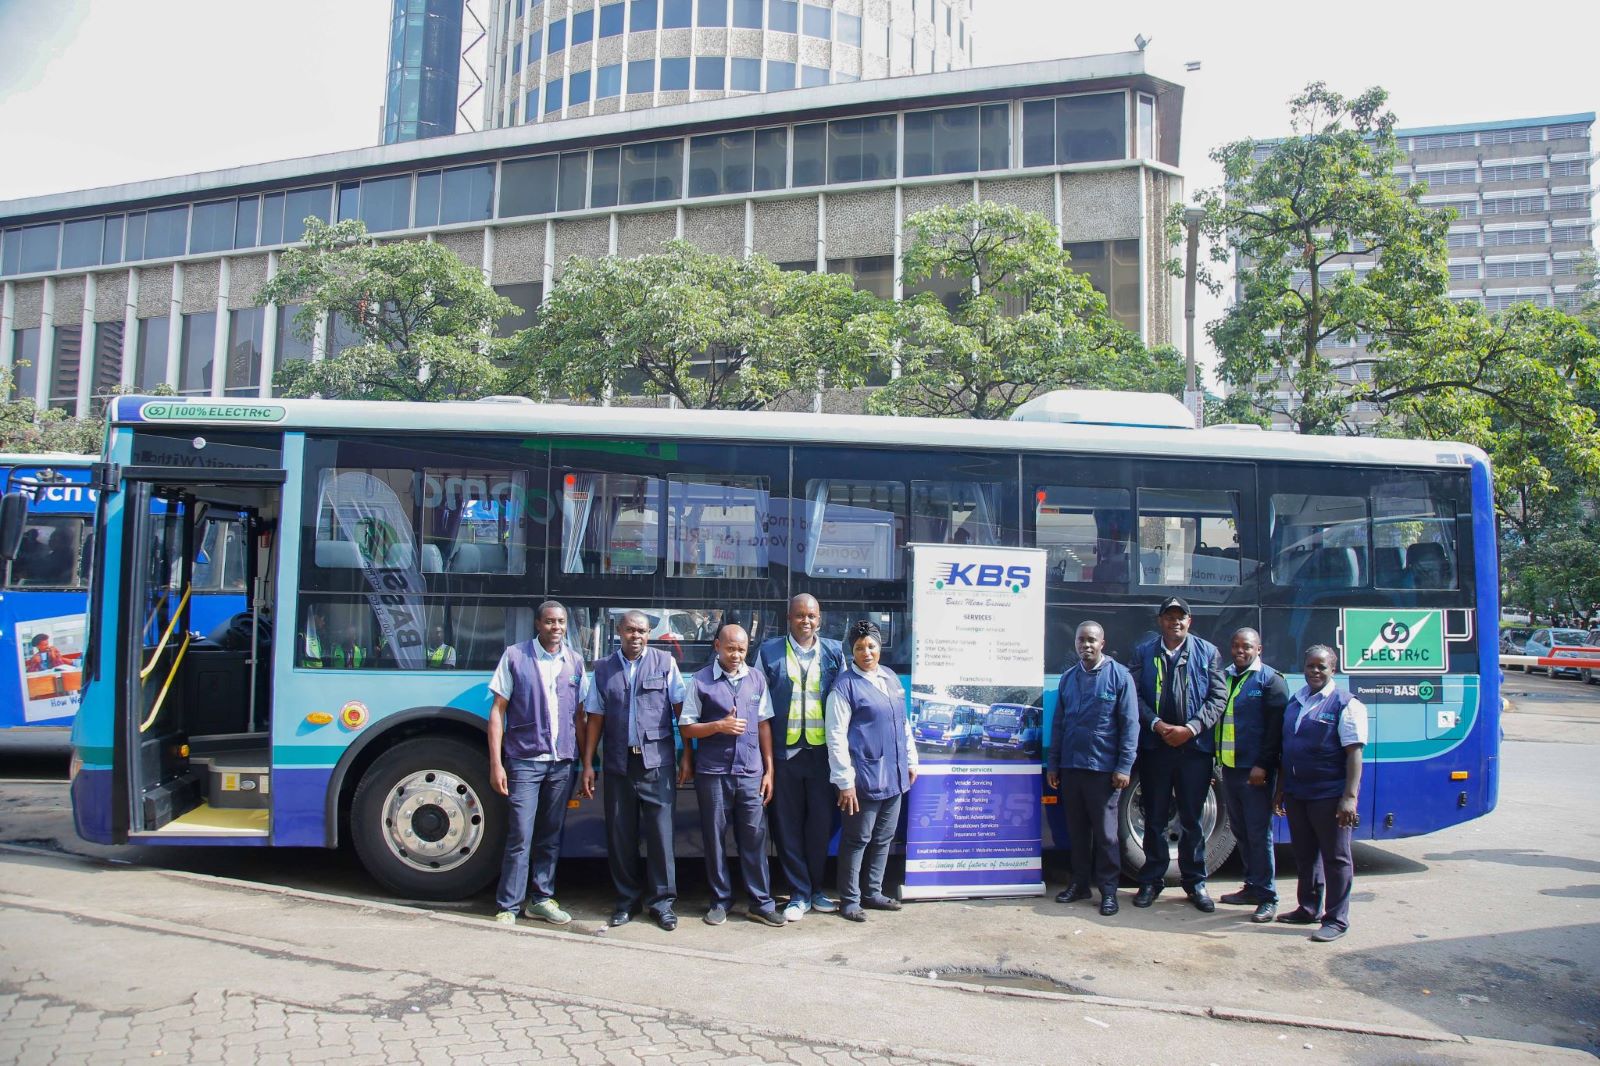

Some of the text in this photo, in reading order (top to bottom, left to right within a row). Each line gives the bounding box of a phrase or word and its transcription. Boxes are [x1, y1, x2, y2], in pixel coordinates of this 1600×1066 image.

[174, 406, 206, 416] 100%
[947, 562, 1032, 589] KBS
[1385, 687, 1392, 695] by
[956, 860, 966, 868] the
[967, 861, 988, 869] future
[990, 860, 997, 868] of
